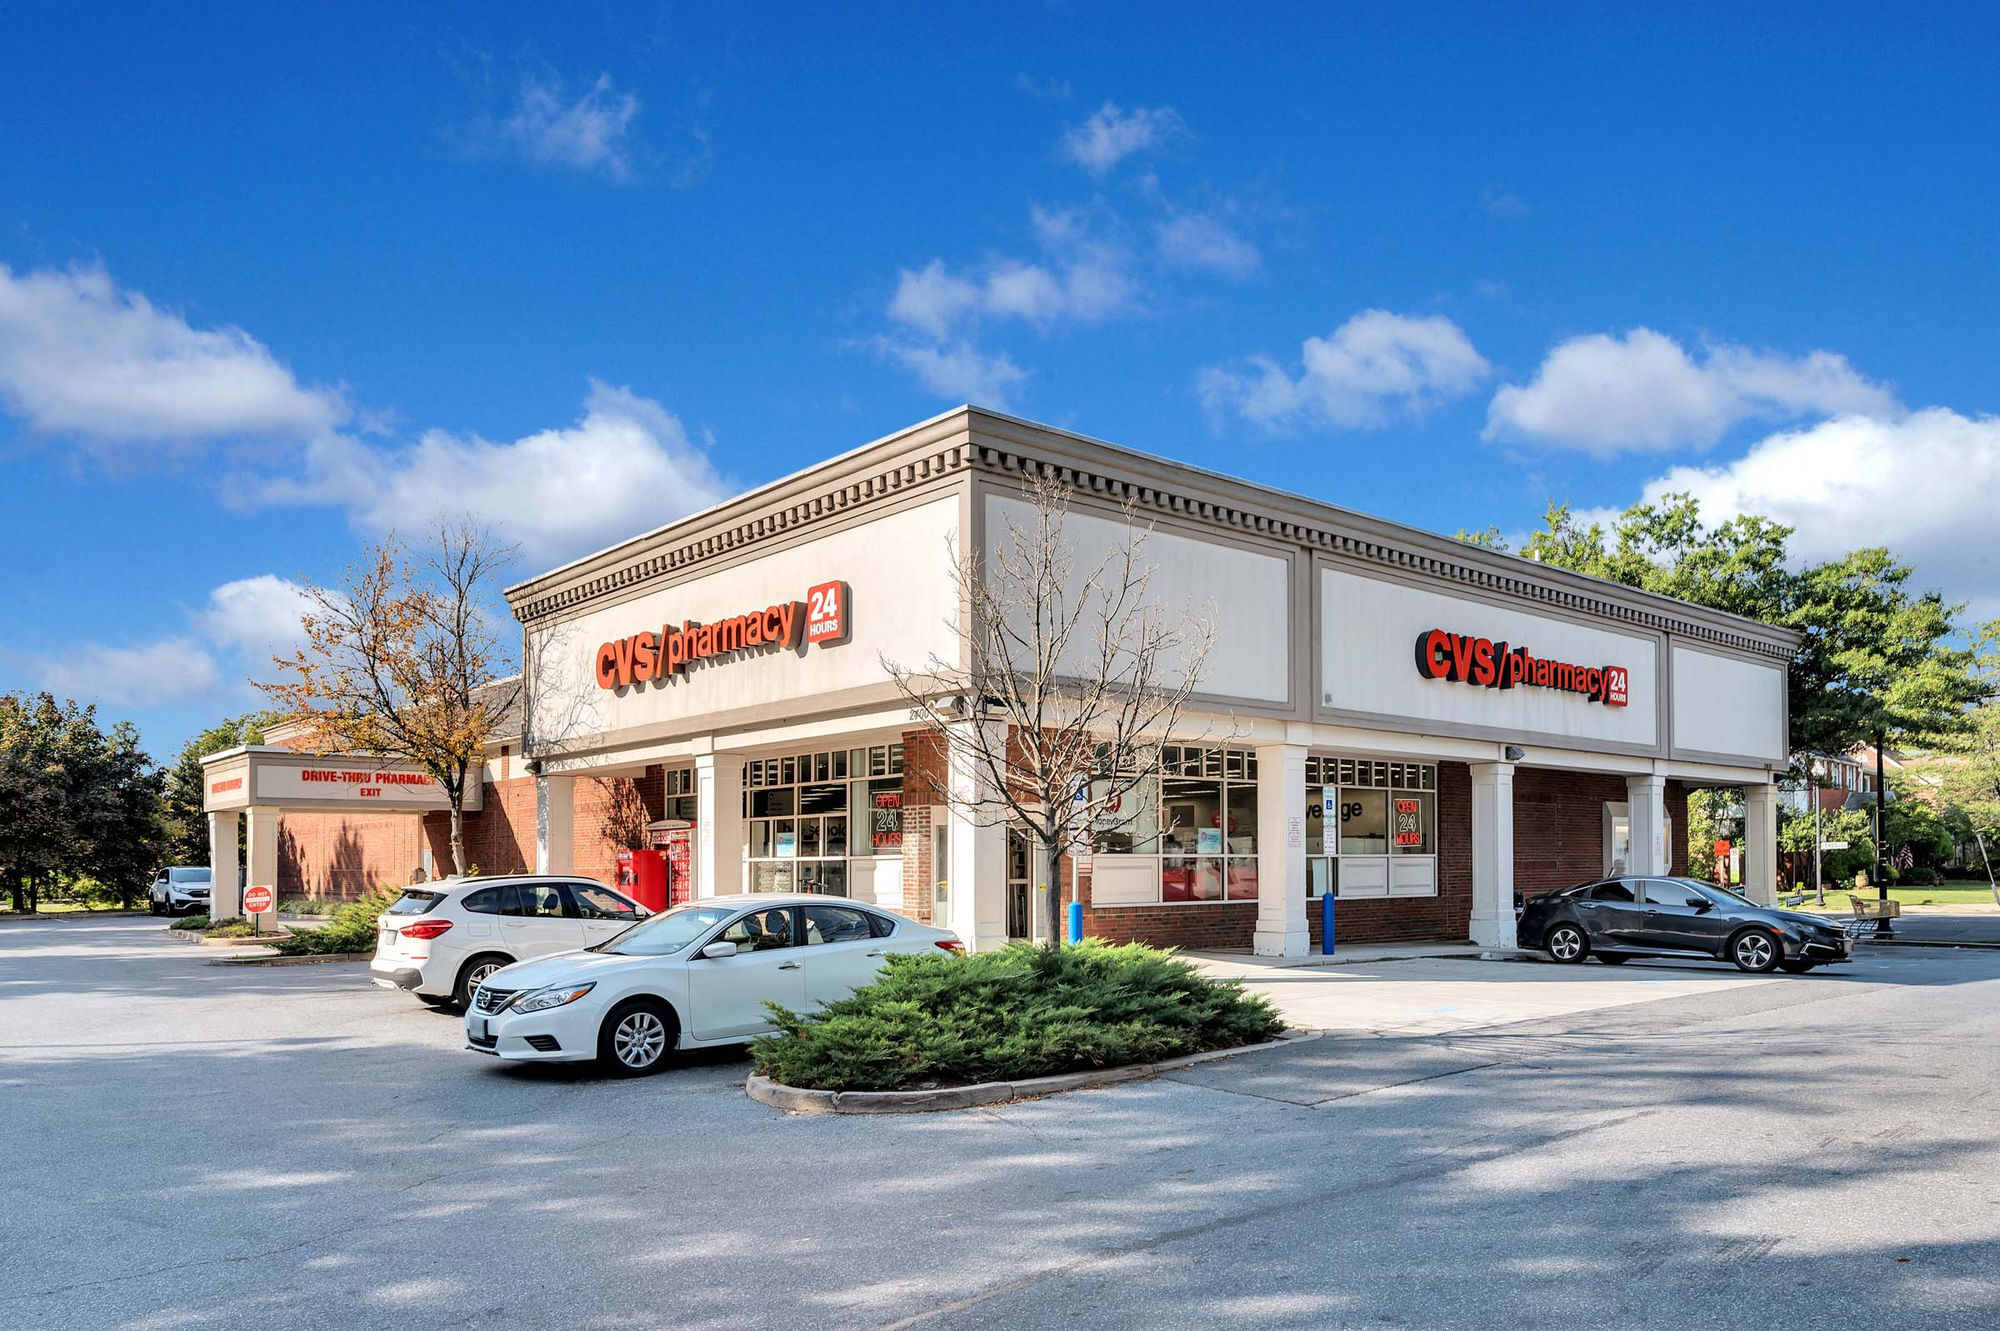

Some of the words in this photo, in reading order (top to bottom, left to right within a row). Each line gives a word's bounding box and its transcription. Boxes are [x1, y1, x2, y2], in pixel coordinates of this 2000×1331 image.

[810, 588, 837, 620] 24
[810, 619, 837, 636] HOURS
[596, 600, 798, 690] CVS/pharmacy
[1425, 628, 1609, 702] CVS/pharmacy
[1610, 670, 1626, 692] 24
[1610, 692, 1627, 703] HOURS
[302, 770, 372, 783] DRIVE-THRU
[360, 788, 382, 797] EXIT
[875, 793, 900, 809] OPEN
[1397, 800, 1417, 813] OPEN
[876, 809, 898, 831] 24
[1399, 814, 1417, 832] 24
[871, 832, 902, 847] HOURS
[1396, 832, 1420, 845] HOURS
